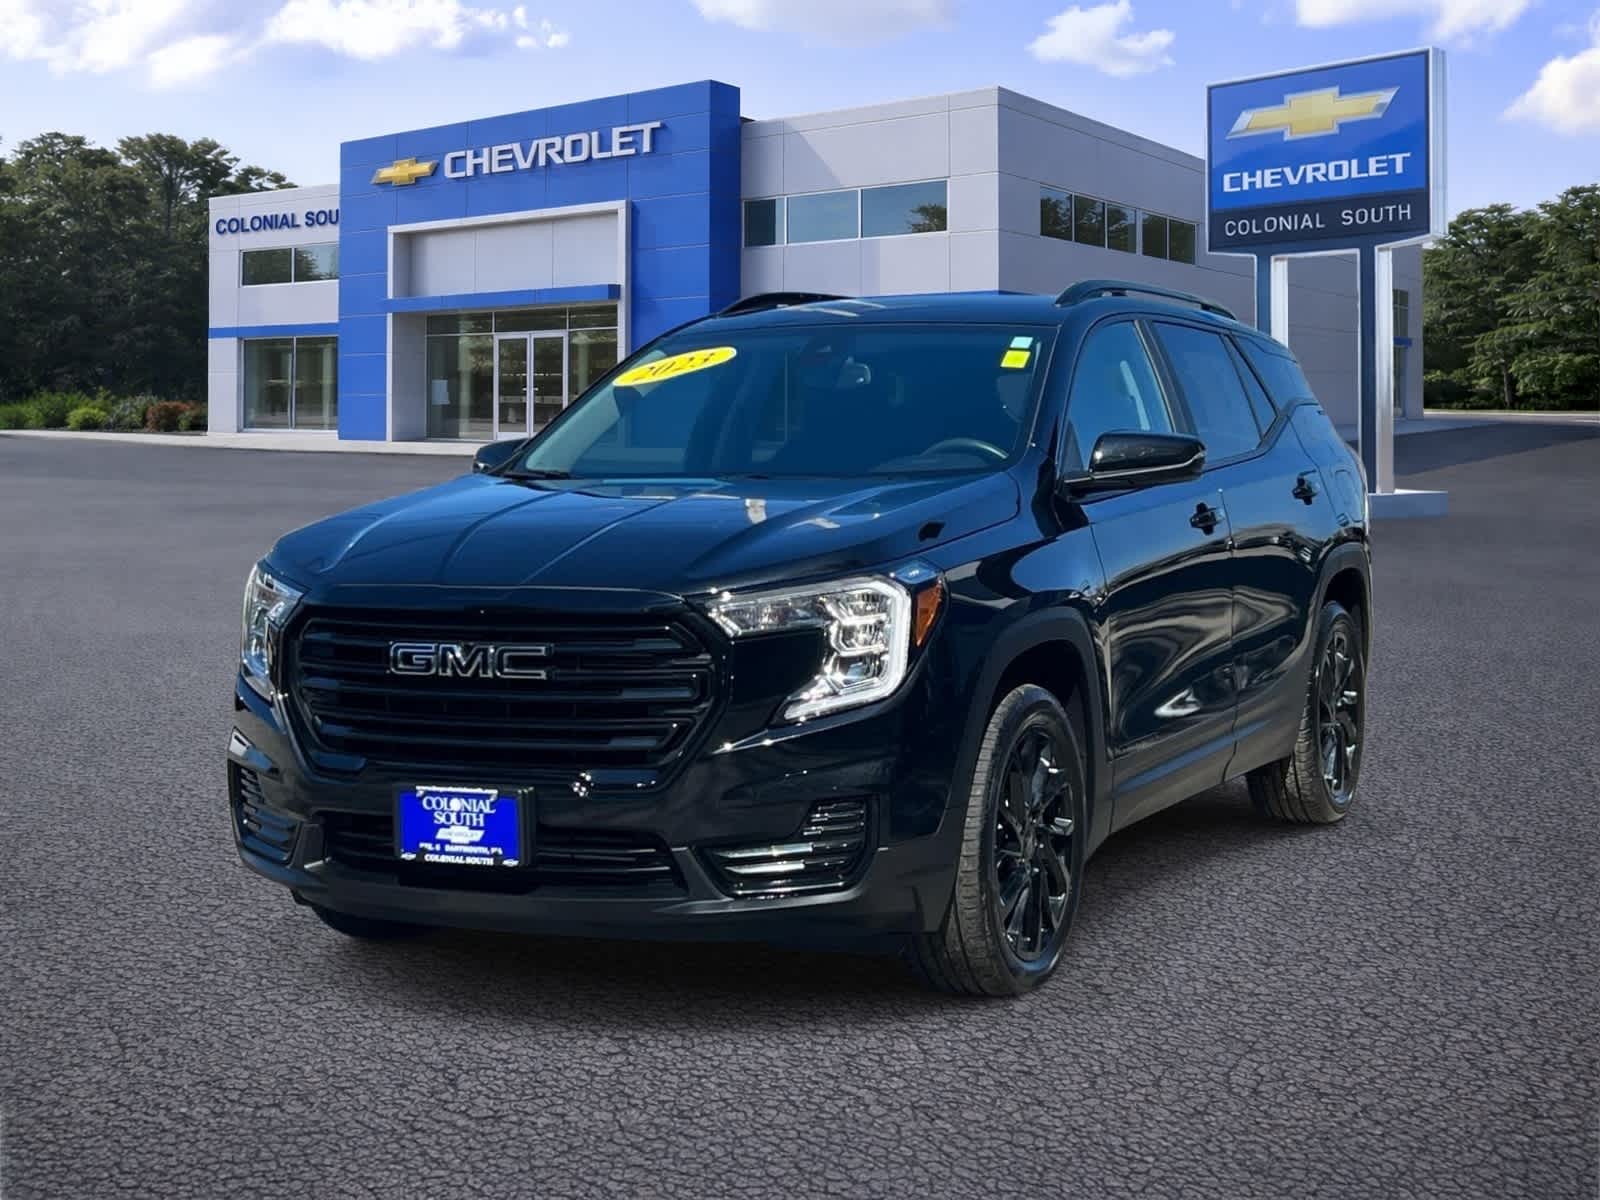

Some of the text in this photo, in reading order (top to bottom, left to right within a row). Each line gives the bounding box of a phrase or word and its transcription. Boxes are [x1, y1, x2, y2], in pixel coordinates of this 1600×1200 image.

[443, 121, 663, 179] CHEVROLET
[1222, 152, 1412, 192] CHEVROLET
[215, 213, 301, 235] COLONIAL
[1224, 203, 1412, 237] COLONIAL SOUTH
[389, 642, 548, 680] GMC
[422, 796, 497, 814] COLONIAL
[433, 811, 485, 827] SOUTH
